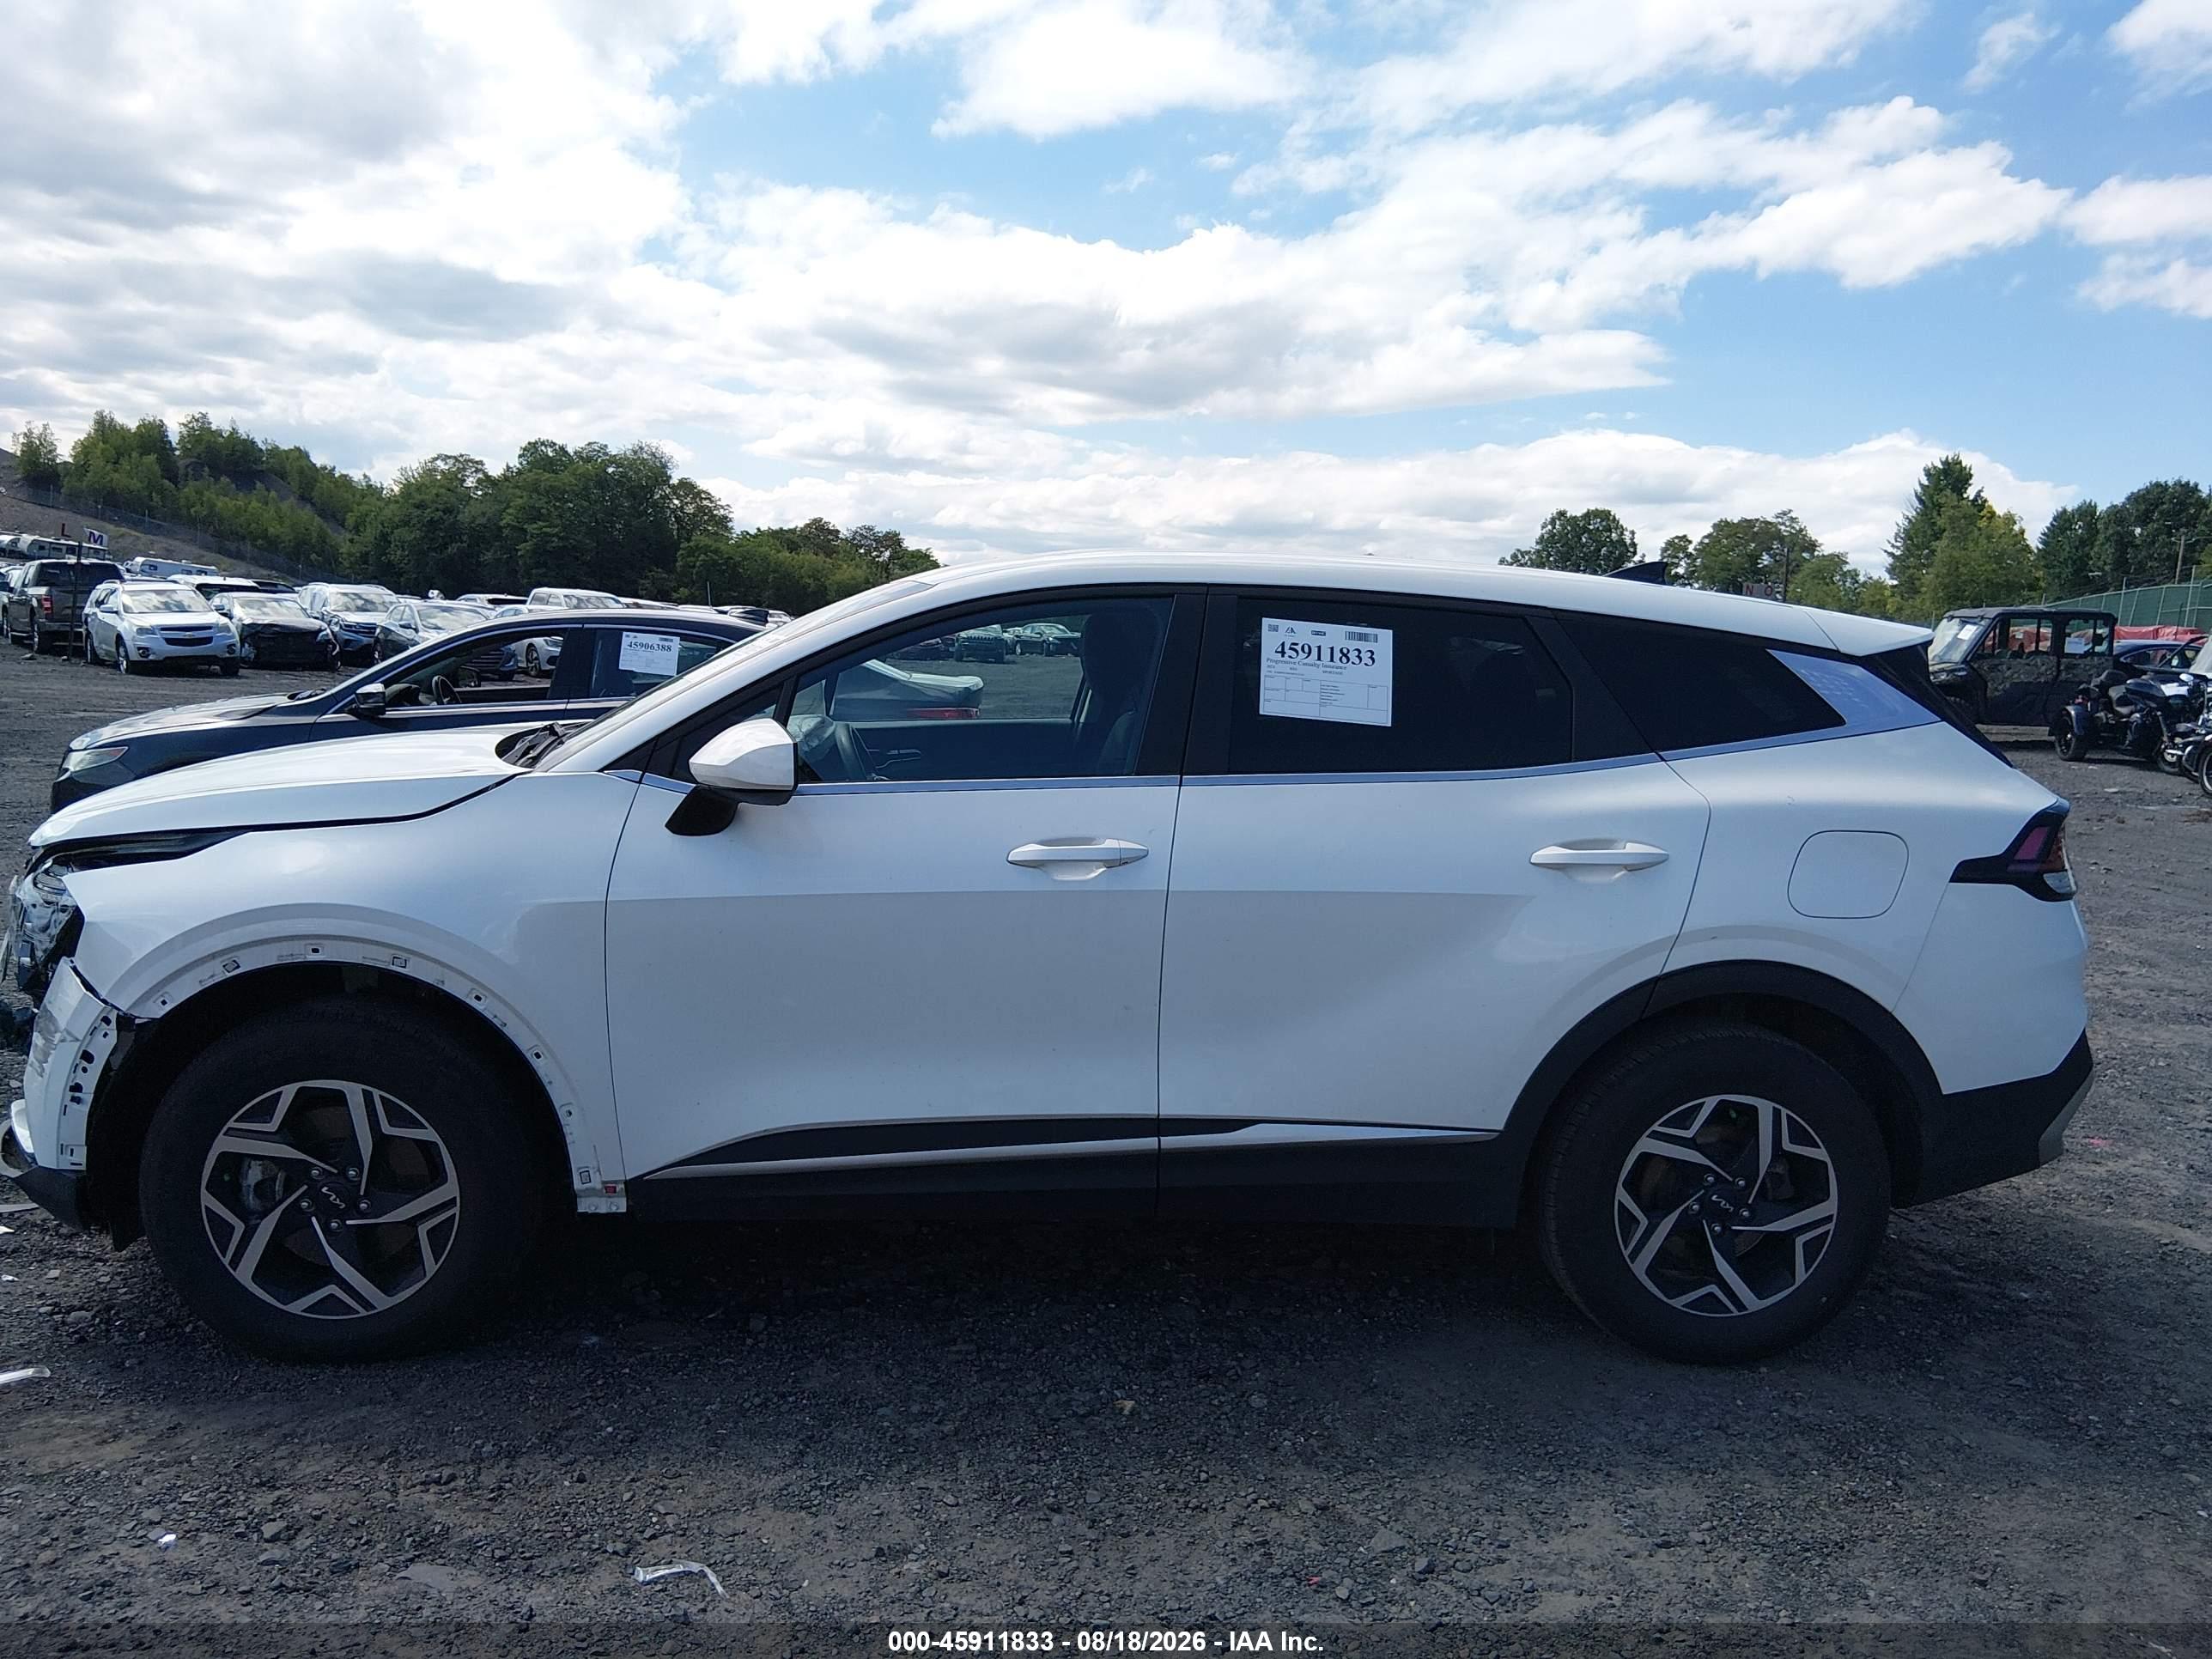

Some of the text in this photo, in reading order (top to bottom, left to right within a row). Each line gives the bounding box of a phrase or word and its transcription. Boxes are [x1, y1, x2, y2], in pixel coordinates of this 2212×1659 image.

[61, 523, 72, 538] L
[89, 531, 103, 545] M
[627, 641, 672, 653] 45906388
[1274, 641, 1376, 667] 45911833
[1267, 658, 1297, 666] Progressive
[1297, 660, 1321, 669] Casualty
